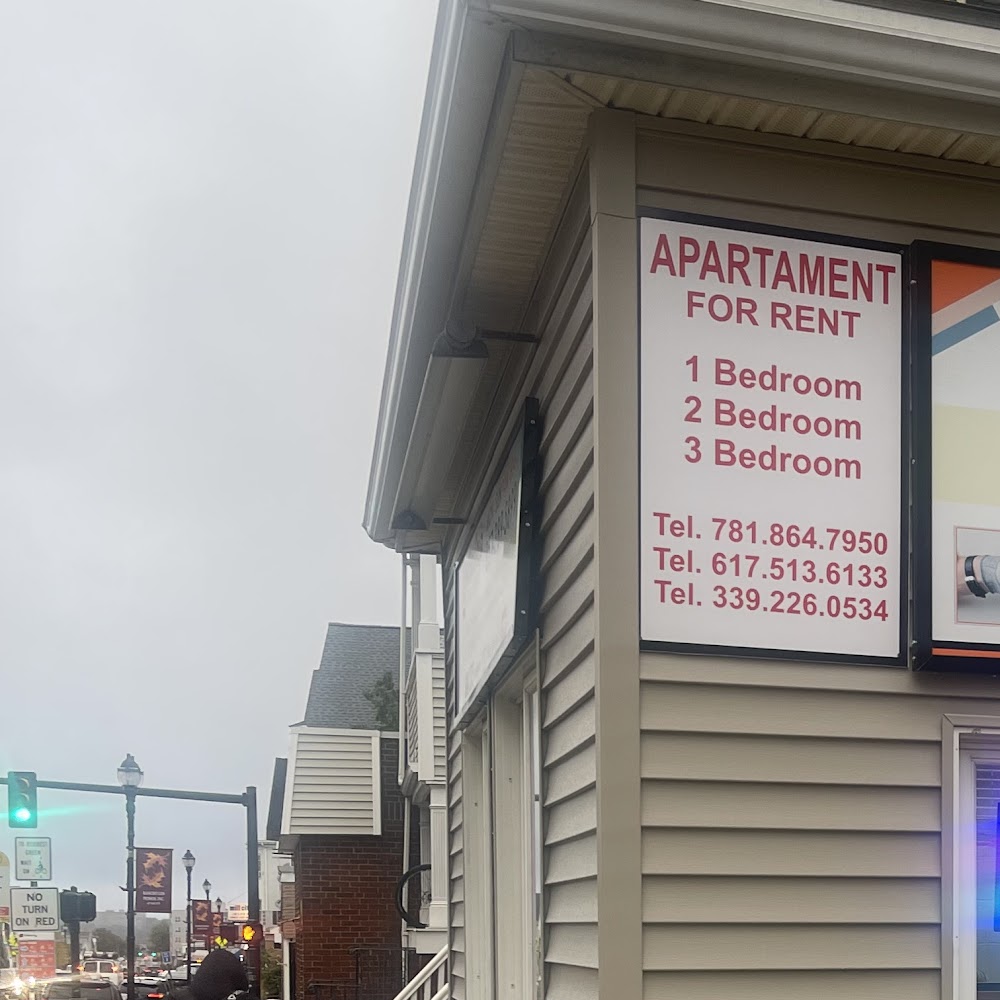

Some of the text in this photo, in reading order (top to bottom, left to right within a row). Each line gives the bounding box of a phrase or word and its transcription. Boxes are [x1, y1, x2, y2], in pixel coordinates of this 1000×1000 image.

[650, 233, 896, 304] APARTAMENT
[687, 290, 861, 338] FOR RENT
[685, 355, 862, 400] 1 Bedroom
[684, 395, 862, 440] 2 Bedroom
[684, 436, 862, 479] 3 Bedroom
[653, 512, 888, 555] Tel. 781.864.7950
[653, 546, 888, 589] Tel. 617.513.6133
[654, 579, 889, 622] Tel. 339.226.0534
[22, 905, 48, 914] TURN
[27, 893, 43, 901] NO
[15, 917, 55, 926] ON RED
